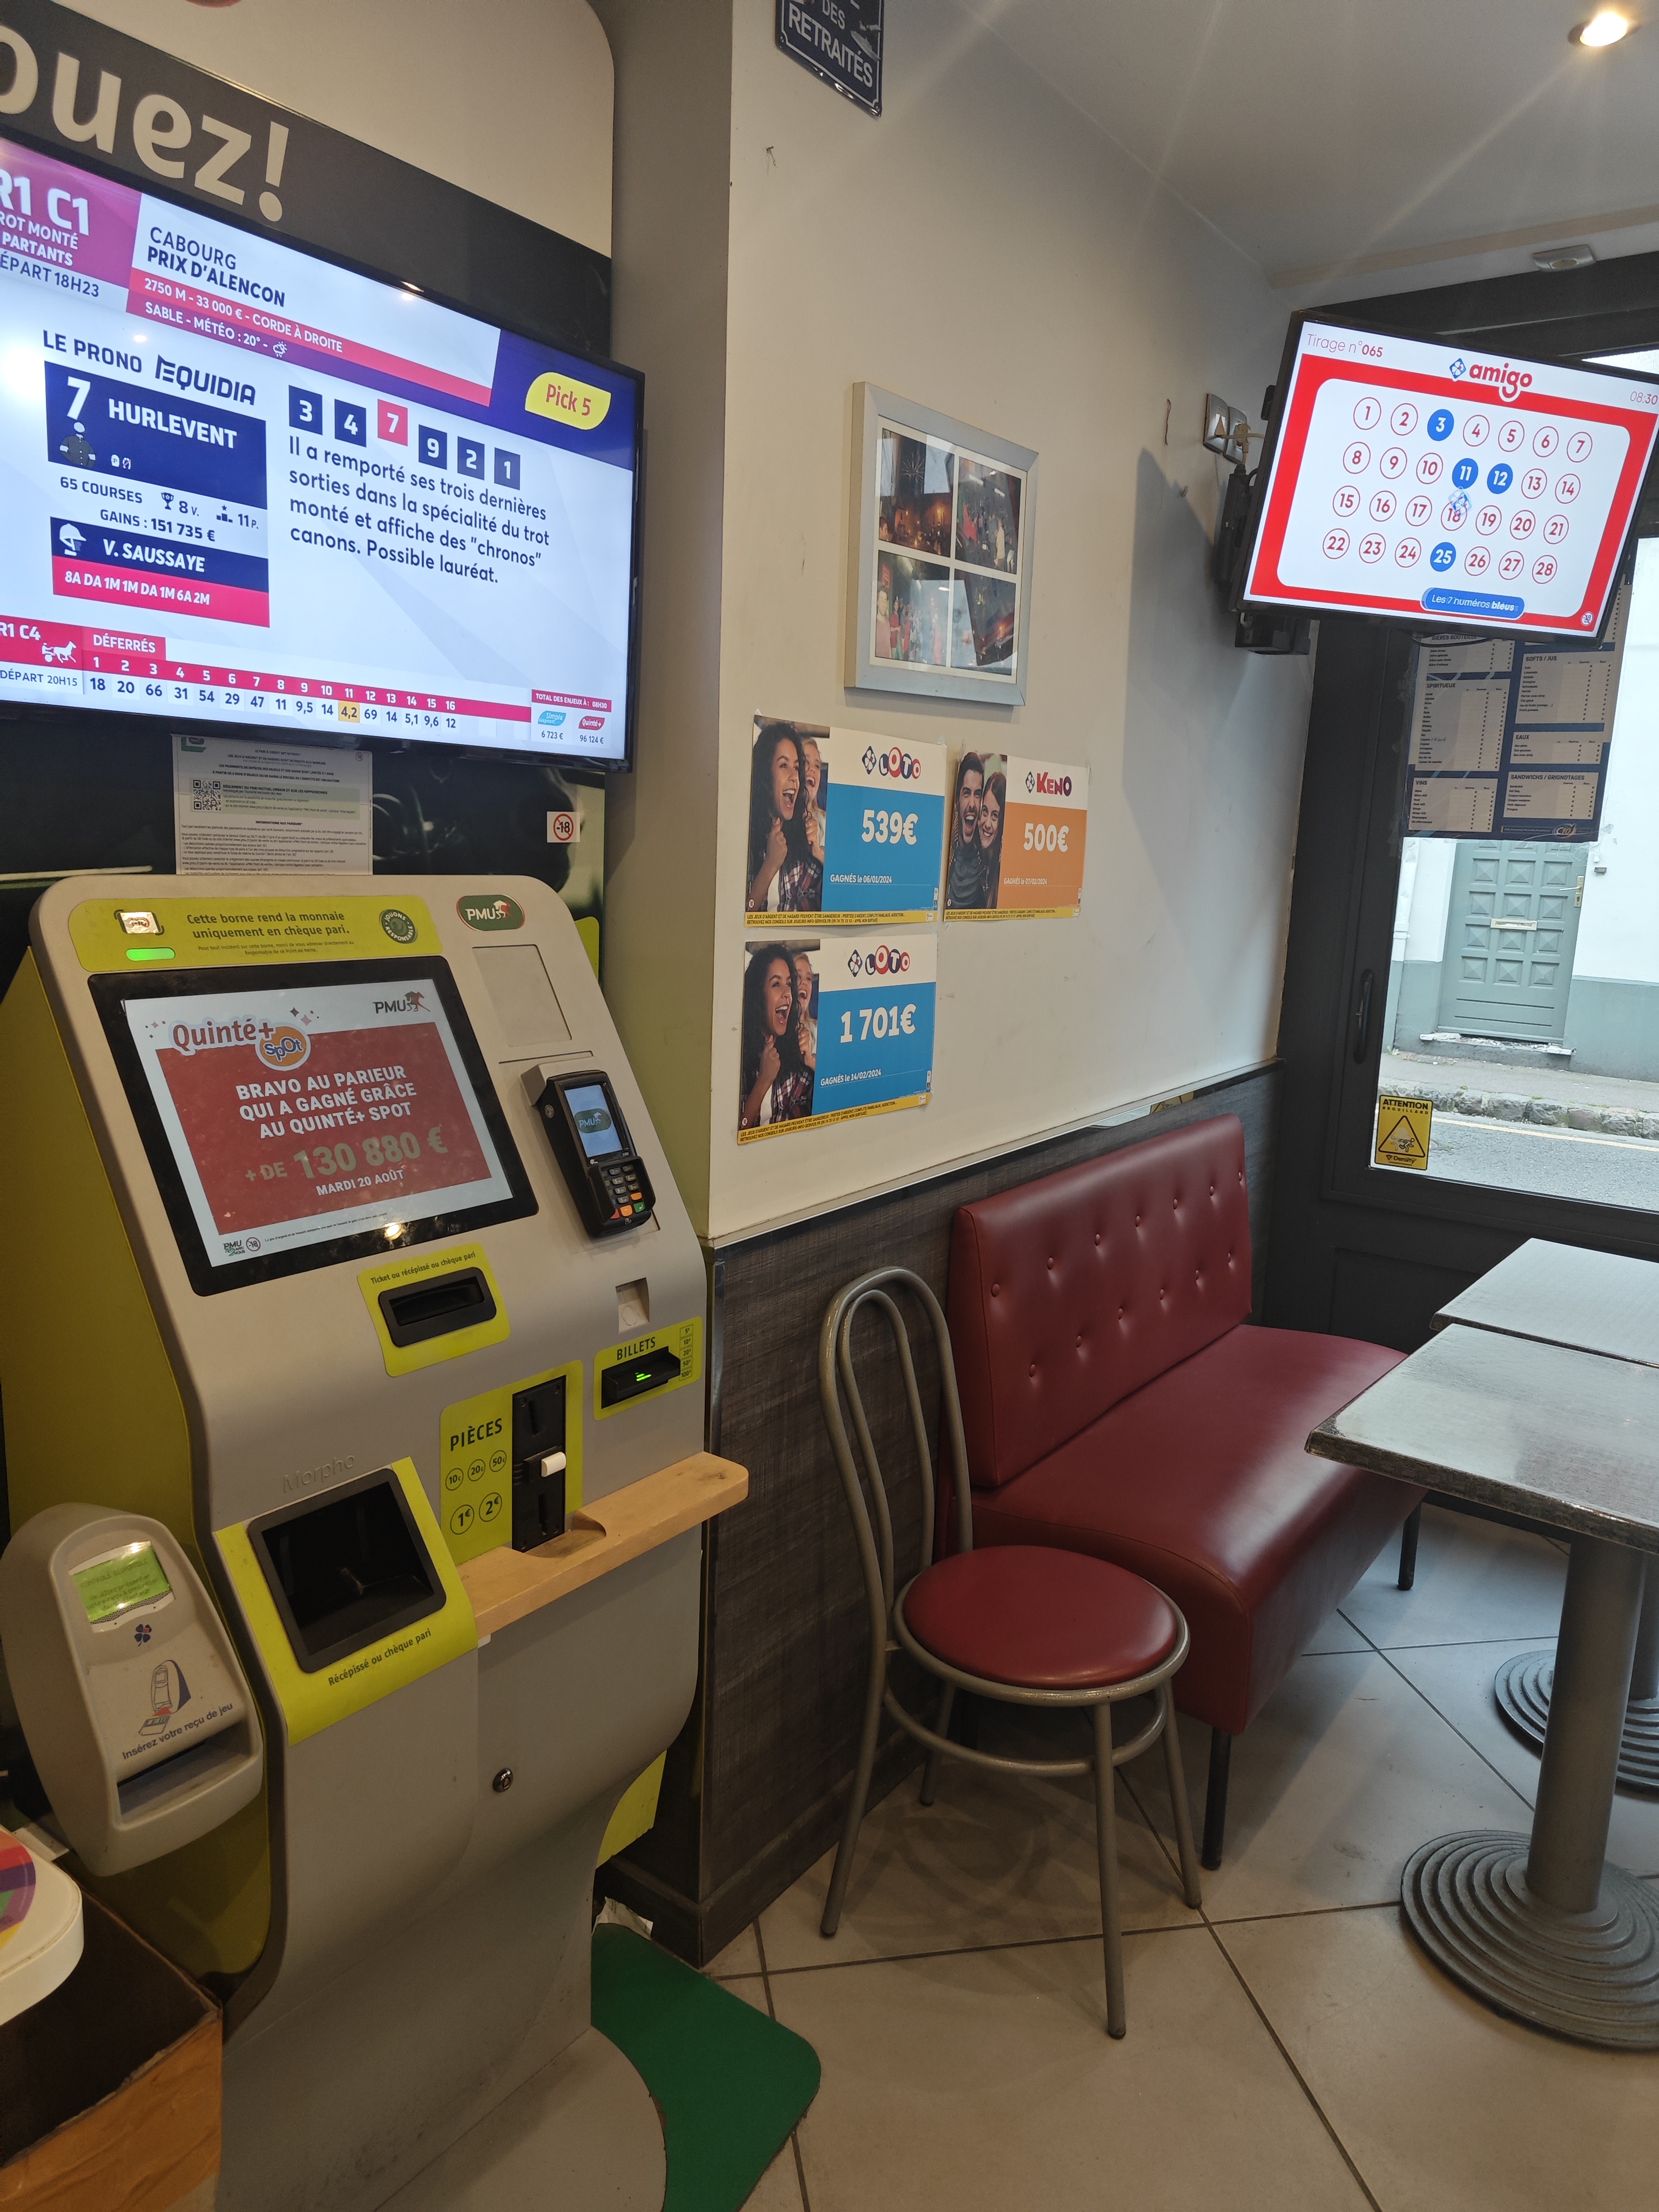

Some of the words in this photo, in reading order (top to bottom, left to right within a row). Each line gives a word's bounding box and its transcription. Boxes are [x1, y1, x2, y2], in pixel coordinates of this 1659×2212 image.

[822, 0, 845, 30] DES
[789, 3, 873, 87] RETRAITÉS
[3, 231, 73, 266] PARTANTS
[150, 226, 236, 269] CABOURG
[54, 272, 99, 297] 18H23
[147, 246, 186, 274] PRIX
[191, 261, 285, 307] D'ALENCON
[145, 278, 172, 296] 2750
[176, 287, 186, 301] M
[197, 295, 209, 309] 33
[212, 300, 232, 316] 000
[235, 309, 242, 320] €
[253, 314, 291, 336] CORDE
[294, 324, 302, 339] À
[305, 331, 342, 353] DROITE
[145, 302, 183, 324] SABLE
[194, 316, 234, 340] MÉTÉO
[244, 333, 260, 347] 20°
[1307, 333, 1345, 354] Tirage
[43, 329, 66, 353] LE
[74, 339, 142, 373] PRONO
[155, 354, 256, 406] EQUIDIA
[1469, 363, 1532, 398] amigo
[545, 383, 577, 413] Pick
[582, 397, 591, 416] 5
[1630, 390, 1658, 406] 08:30
[109, 398, 237, 449] HURLEVENT
[60, 477, 77, 490] 65
[82, 481, 143, 504] COURSES
[289, 436, 300, 456] Il
[306, 444, 317, 461] a
[325, 449, 405, 483] remporté
[410, 474, 435, 491] ses
[440, 477, 474, 502] trois
[479, 489, 546, 521] dernières
[289, 467, 350, 496] sorties
[356, 483, 397, 509] dans
[402, 493, 417, 514] la
[422, 503, 497, 532] spécialité
[502, 515, 520, 538] du
[524, 522, 549, 545] trot
[100, 509, 140, 527] GAINS
[151, 517, 172, 534] 151
[177, 523, 203, 539] 735
[207, 530, 215, 542] €
[289, 497, 349, 524] monté
[355, 513, 372, 529] et
[377, 514, 434, 543] affiche
[440, 528, 466, 551] des
[103, 538, 118, 557] V.
[122, 542, 205, 573] SAUSSAYE
[290, 527, 361, 554] canons.
[367, 539, 434, 569] Possible
[440, 555, 498, 583] lauréat.
[1432, 595, 1446, 603] Les
[1454, 598, 1490, 609] numéros
[1491, 601, 1515, 611] bleus
[93, 633, 156, 653] DÉFERRÉS
[582, 719, 601, 727] Quinté+
[879, 746, 921, 779] LOTO
[862, 809, 918, 845] 539€
[1023, 822, 1069, 853] 500€
[830, 874, 856, 883] GAGNÉS
[857, 874, 862, 883] le
[863, 875, 892, 884] 06/01/2024
[1025, 878, 1047, 886] 07/02/2024
[187, 914, 217, 924] Cette
[220, 914, 254, 923] borne
[258, 913, 283, 922] rend
[286, 913, 296, 921] la
[299, 911, 345, 921] monnaie
[384, 912, 406, 922] JOUONS
[464, 907, 496, 920] PMU
[193, 927, 264, 940] uniquement
[267, 928, 281, 936] en
[285, 926, 322, 936] chèque
[325, 925, 349, 935] pari.
[385, 925, 413, 941] RESPONSABLE
[865, 945, 910, 975] LOTO
[373, 1000, 407, 1014] PMU
[840, 1011, 853, 1043] 1
[860, 1003, 916, 1041] 701€
[172, 1018, 274, 1050] Quinté+
[235, 1079, 300, 1101] BRAVO
[307, 1075, 329, 1092] AU
[338, 1065, 407, 1086] PARIEUR
[820, 1075, 844, 1086] GAGNÉS
[851, 1069, 881, 1081] 14/02/2024
[239, 1102, 273, 1122] QUI
[280, 1101, 293, 1115] A
[297, 1090, 357, 1112] GAGNÉ
[361, 1083, 417, 1103] GRÂCE
[1383, 1099, 1428, 1110] ATTENTION
[260, 1123, 286, 1139] AU
[291, 1110, 365, 1133] QUINTÉ+
[370, 1102, 412, 1122] SPOT
[260, 1162, 287, 1181] DE
[294, 1143, 356, 1178] 130
[362, 1131, 420, 1166] 880
[427, 1127, 448, 1154] €
[1393, 1156, 1415, 1164] Density
[316, 1178, 356, 1196] MARDI
[357, 1176, 372, 1188] 20
[375, 1169, 404, 1184] AOÛT
[370, 1274, 390, 1284] Ticket
[401, 1265, 430, 1277] récépissé
[441, 1255, 463, 1267] chèque
[464, 1251, 476, 1262] pari
[616, 1337, 656, 1360] BILLETS
[450, 1418, 502, 1451] PIÈCES
[283, 1453, 356, 1494] Morpho
[328, 1659, 368, 1687] Récépissé
[370, 1653, 382, 1663] ou
[383, 1638, 413, 1660] chèque
[415, 1628, 432, 1647] pari
[122, 1737, 158, 1760] Insérez
[159, 1729, 183, 1744] votre
[184, 1718, 205, 1735] reçu
[206, 1711, 218, 1721] de
[219, 1702, 233, 1716] jeu
